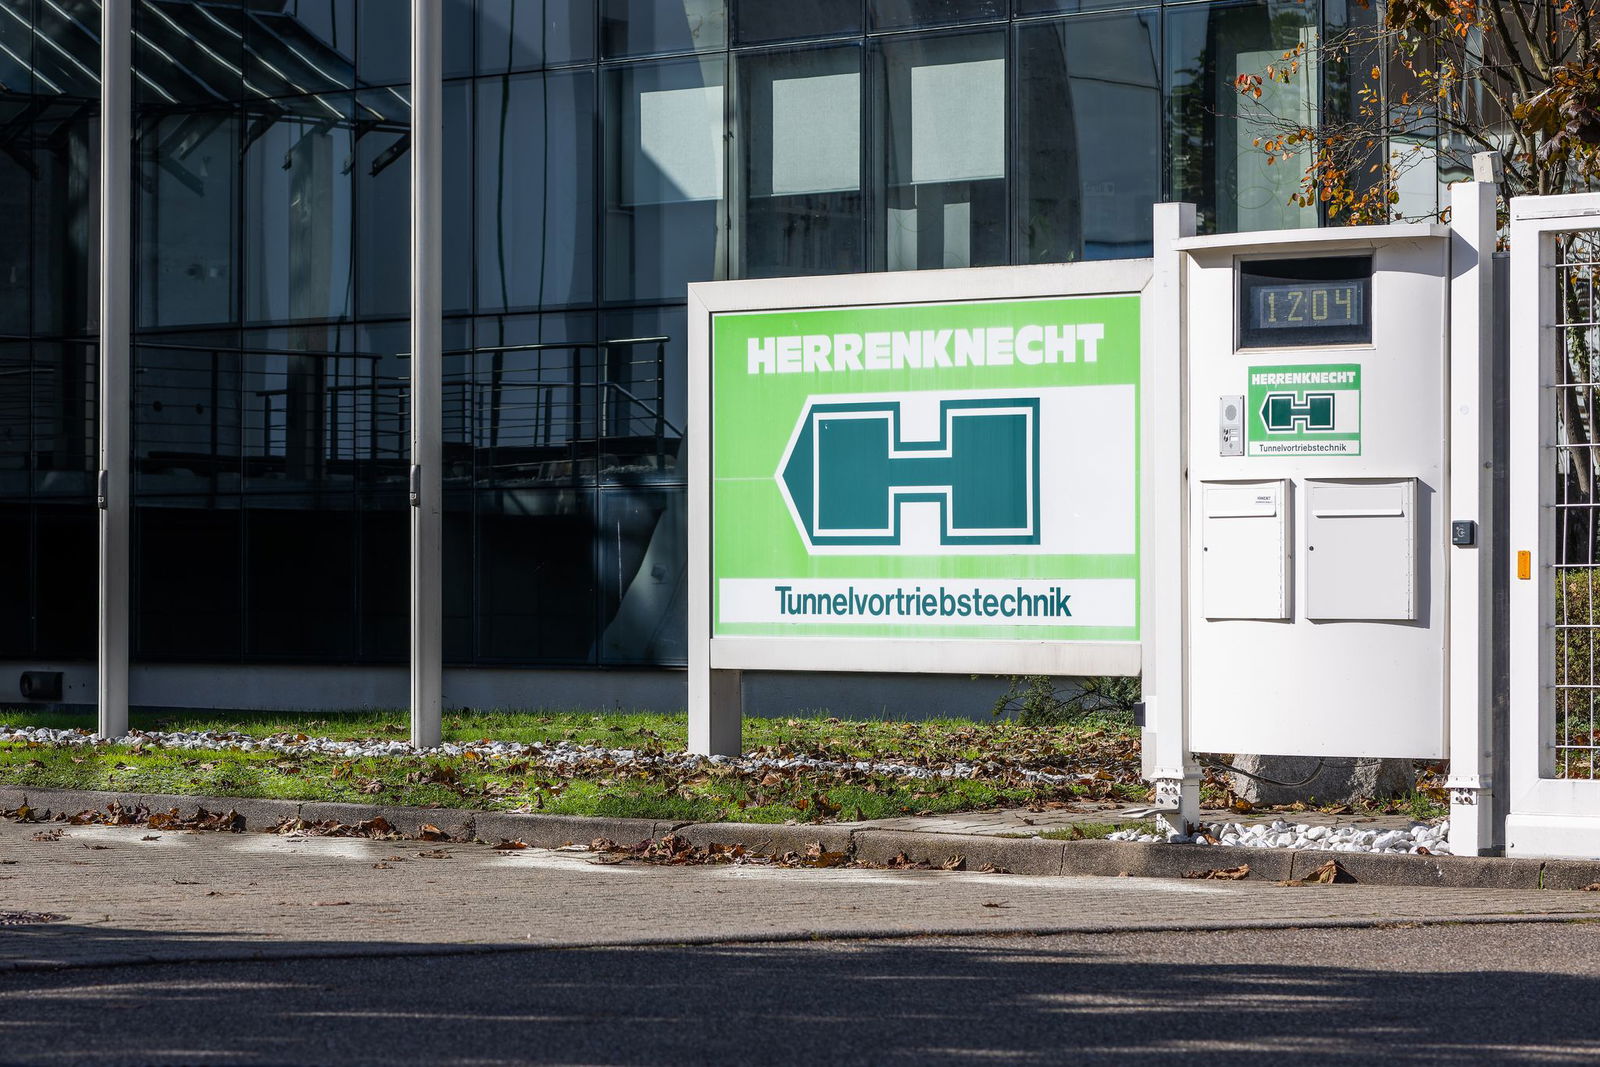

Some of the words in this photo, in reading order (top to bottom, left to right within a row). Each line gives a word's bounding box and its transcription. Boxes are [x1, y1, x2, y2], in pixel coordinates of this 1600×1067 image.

[1267, 289, 1352, 322] 12:04
[747, 323, 1105, 375] HERRENKNECHT
[1251, 371, 1356, 385] HERRENKNECHT
[1259, 443, 1347, 452] Tunnelvortriebstechnik
[774, 586, 1072, 617] Tunnelvortriebstechnik
